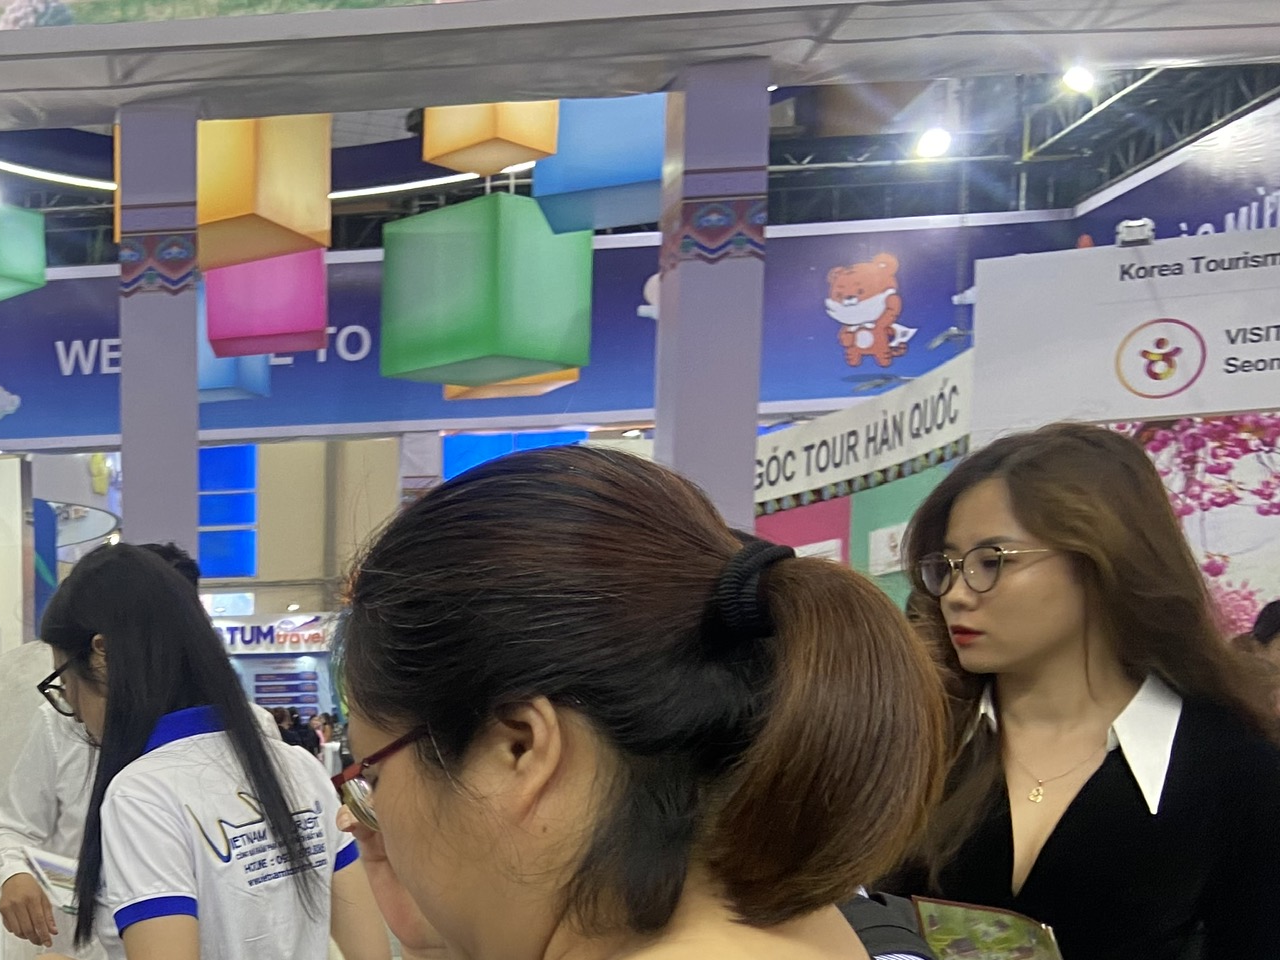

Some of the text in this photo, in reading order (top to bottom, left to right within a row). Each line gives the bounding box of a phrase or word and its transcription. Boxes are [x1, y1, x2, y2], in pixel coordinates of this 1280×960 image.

[1120, 261, 1184, 282] Korea
[803, 429, 860, 477] TOUR
[864, 409, 905, 456] HÀN
[909, 377, 959, 439] QUỐC
